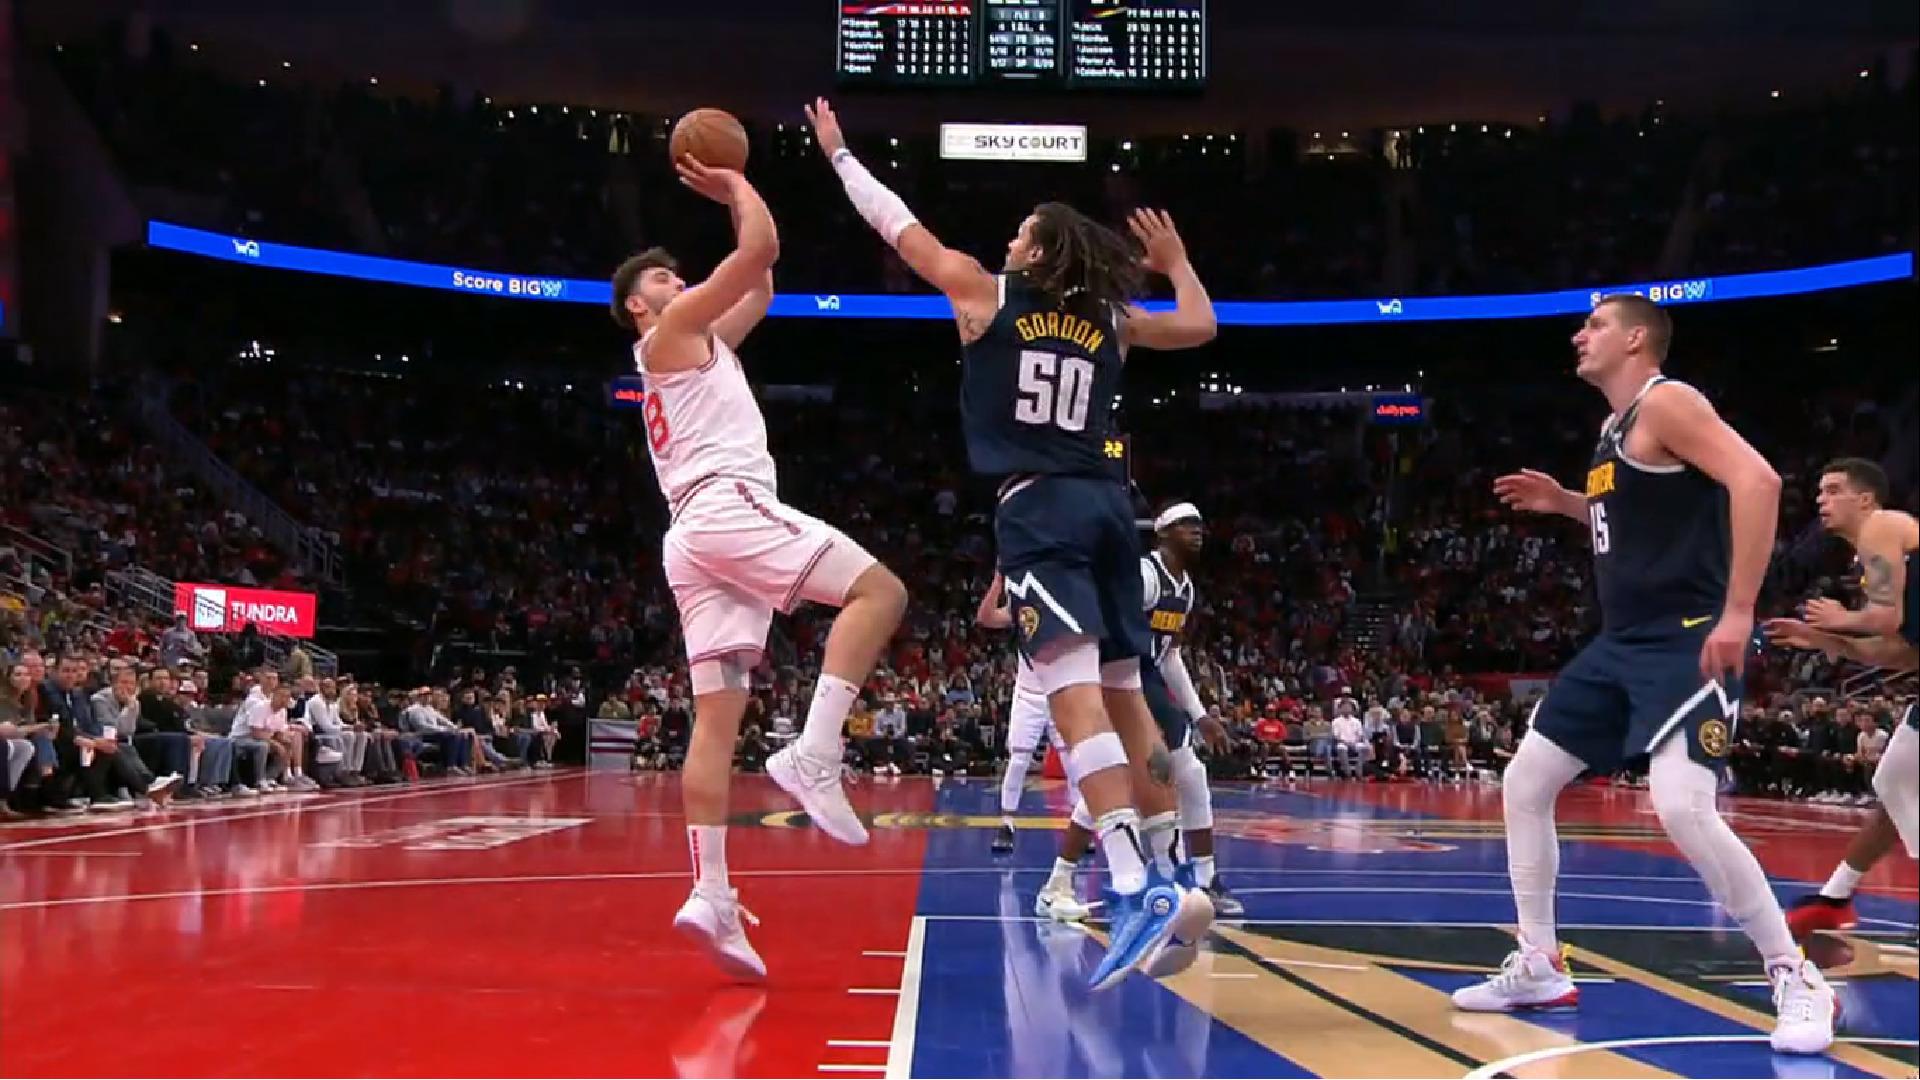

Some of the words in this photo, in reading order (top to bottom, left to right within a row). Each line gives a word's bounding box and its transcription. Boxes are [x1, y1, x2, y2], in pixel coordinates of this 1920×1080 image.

[974, 135, 1014, 149] SKY
[1018, 135, 1082, 150] COURT
[452, 271, 503, 292] Score
[1015, 311, 1105, 353] GORDON
[1014, 350, 1096, 431] 50
[1589, 502, 1611, 556] 15
[231, 600, 299, 624] TUNDRA
